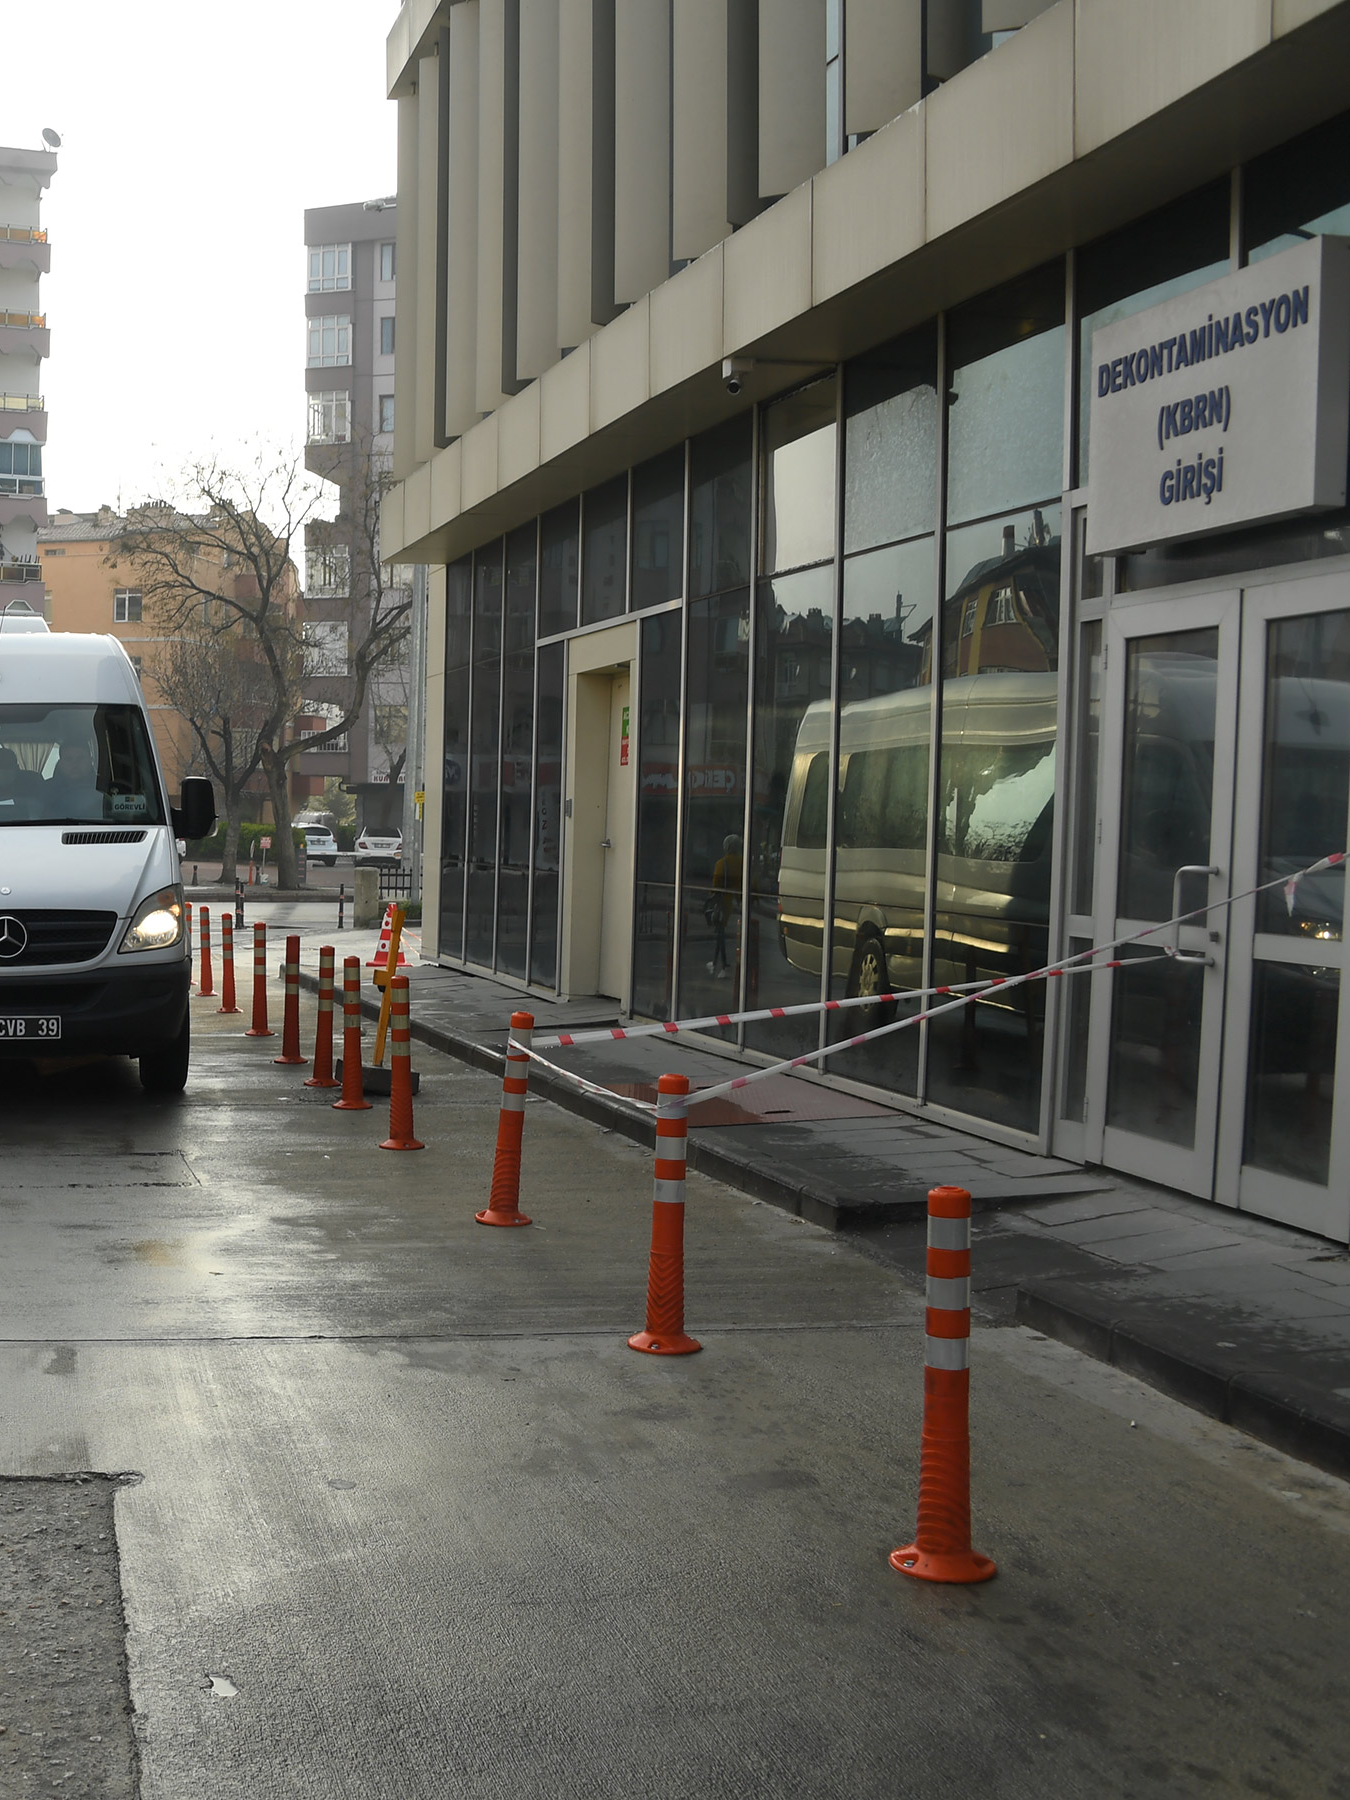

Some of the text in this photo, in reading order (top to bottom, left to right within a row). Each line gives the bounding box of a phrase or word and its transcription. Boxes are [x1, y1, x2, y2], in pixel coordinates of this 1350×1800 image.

[1098, 285, 1309, 397] DEKONTAMİNASYON
[1157, 385, 1231, 450] (KBRN)
[1159, 447, 1224, 505] GİRİŞİ
[38, 1019, 58, 1036] 39
